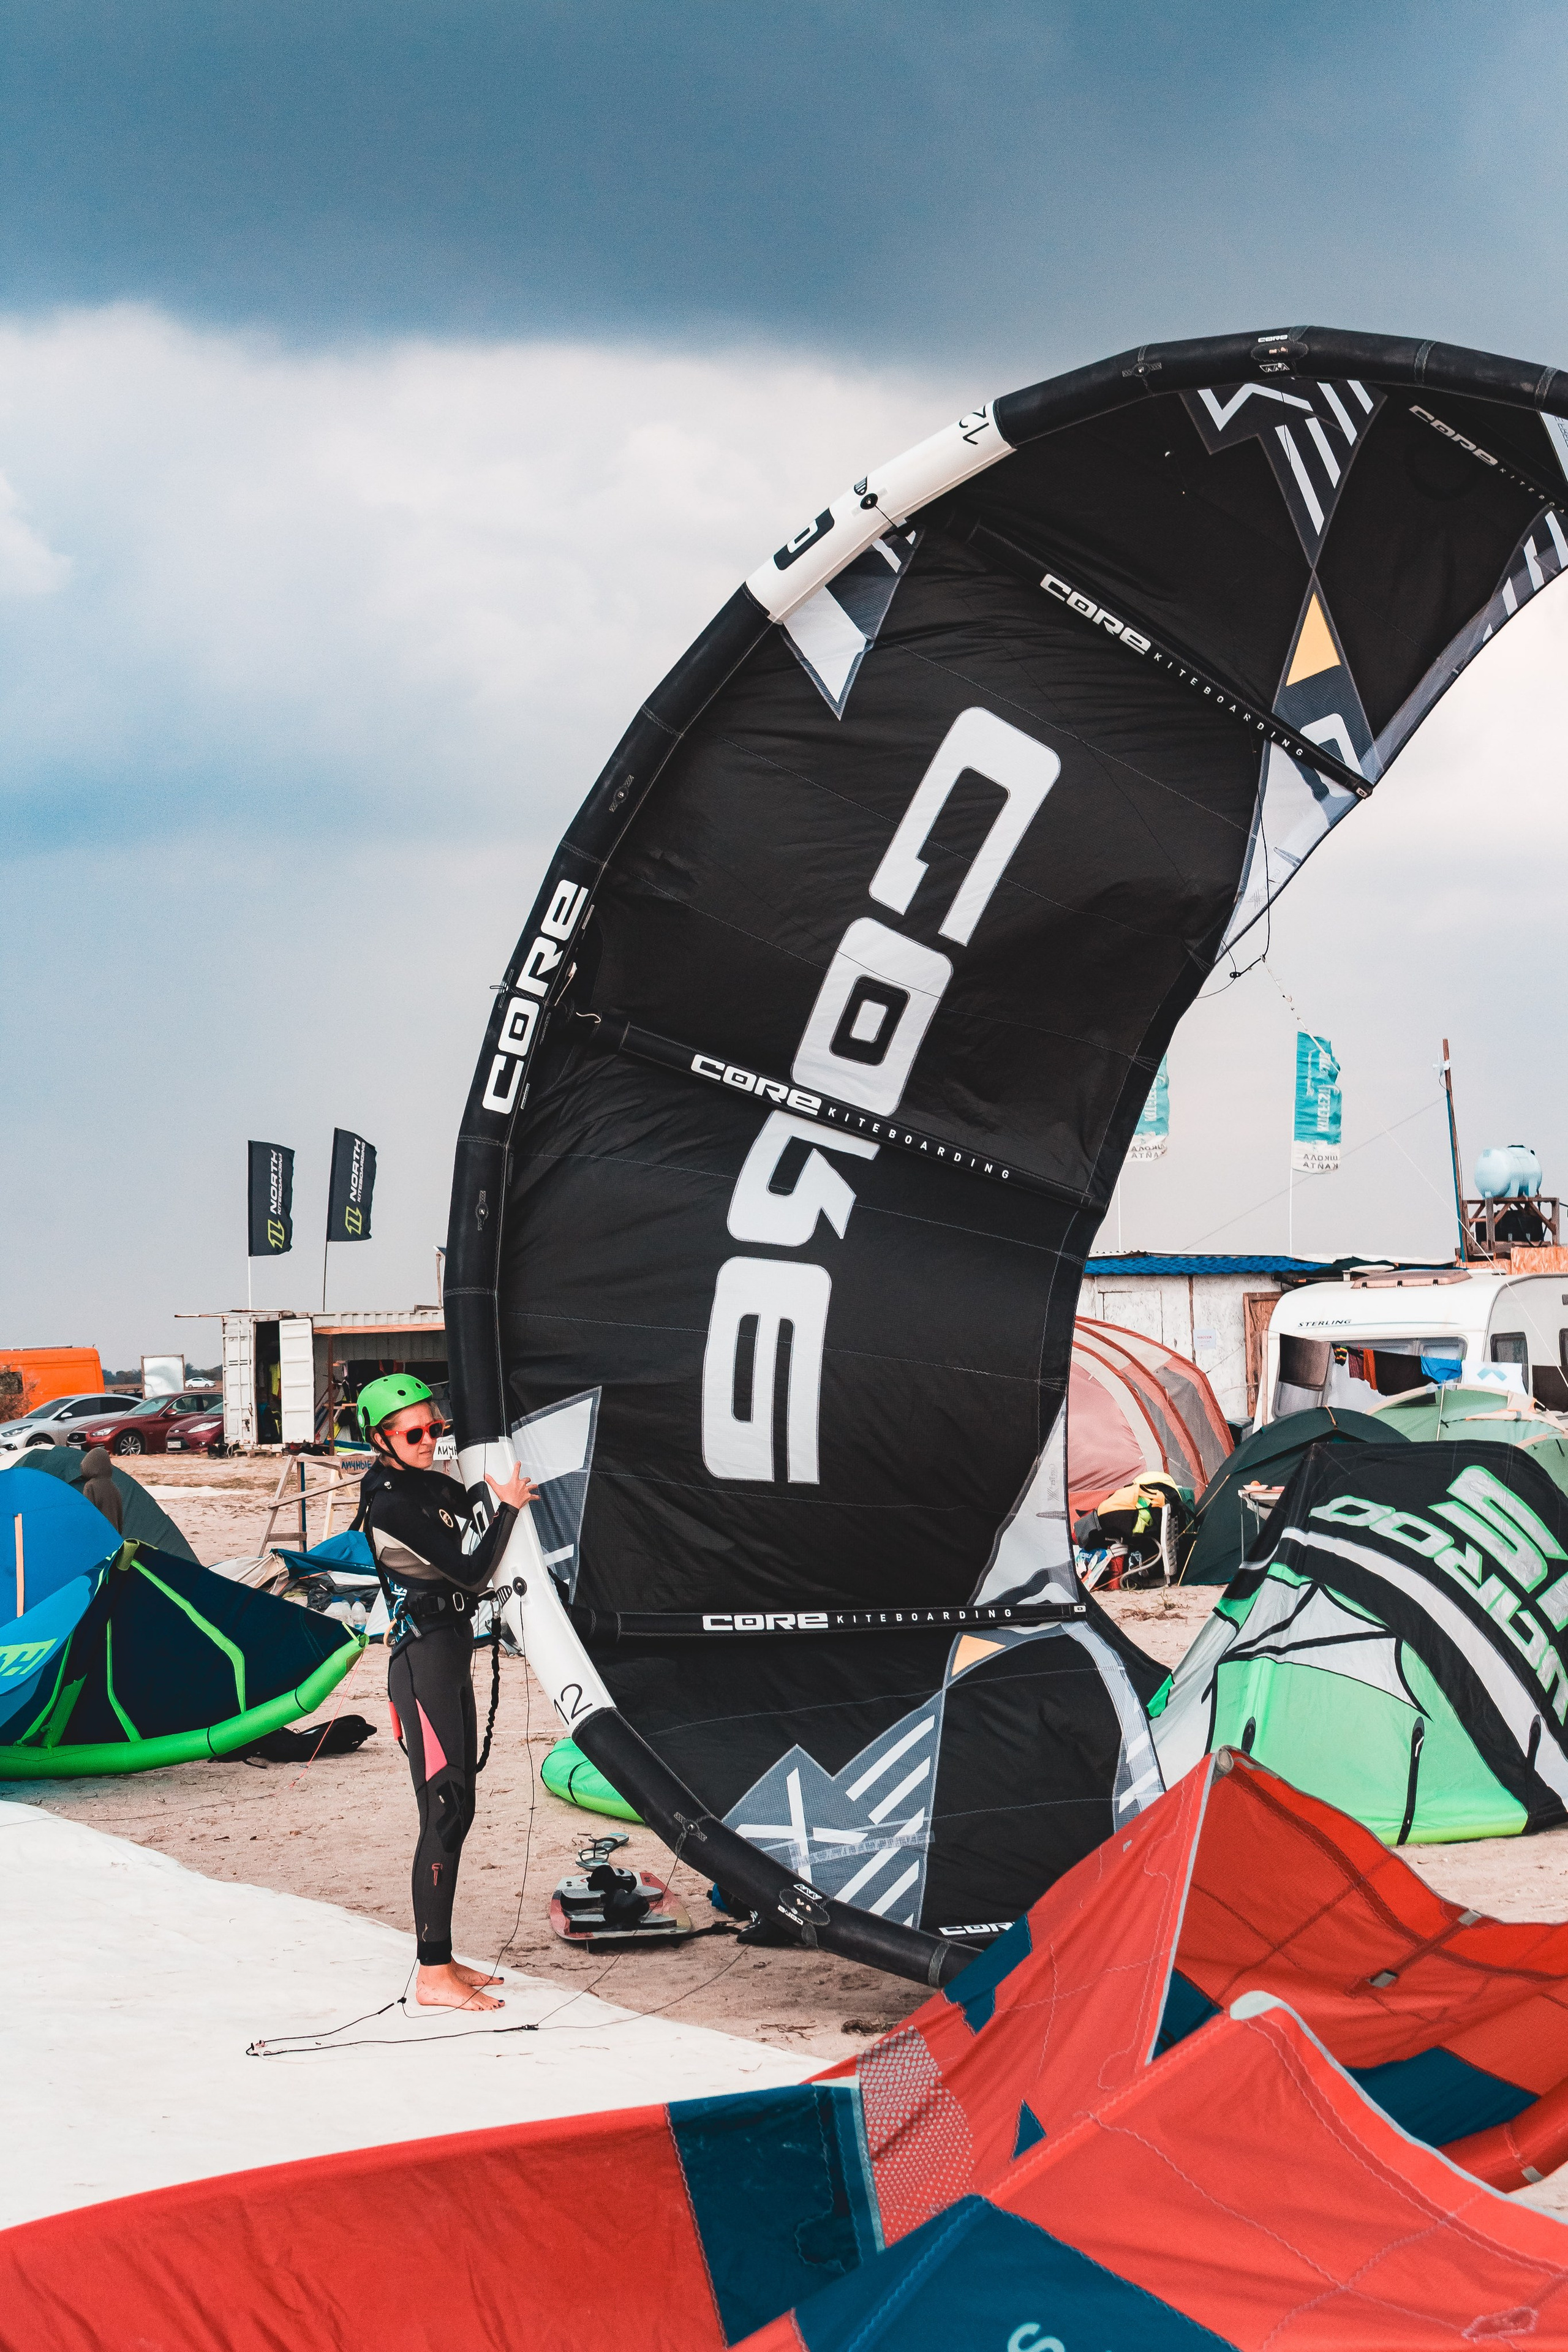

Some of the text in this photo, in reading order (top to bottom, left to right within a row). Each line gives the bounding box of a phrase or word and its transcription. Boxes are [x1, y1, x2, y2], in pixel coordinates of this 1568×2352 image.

[1153, 653, 1304, 756] KITEBOARDING
[828, 1107, 1011, 1180] KITEBOARDING
[350, 1138, 361, 1202] NORTH
[357, 1142, 366, 1203] KITEBOARDING
[1298, 1319, 1352, 1327] STERLING
[837, 1608, 1012, 1624] KITEBOARDING
[554, 1683, 593, 1726] 12
[939, 1921, 1016, 1936] COR
